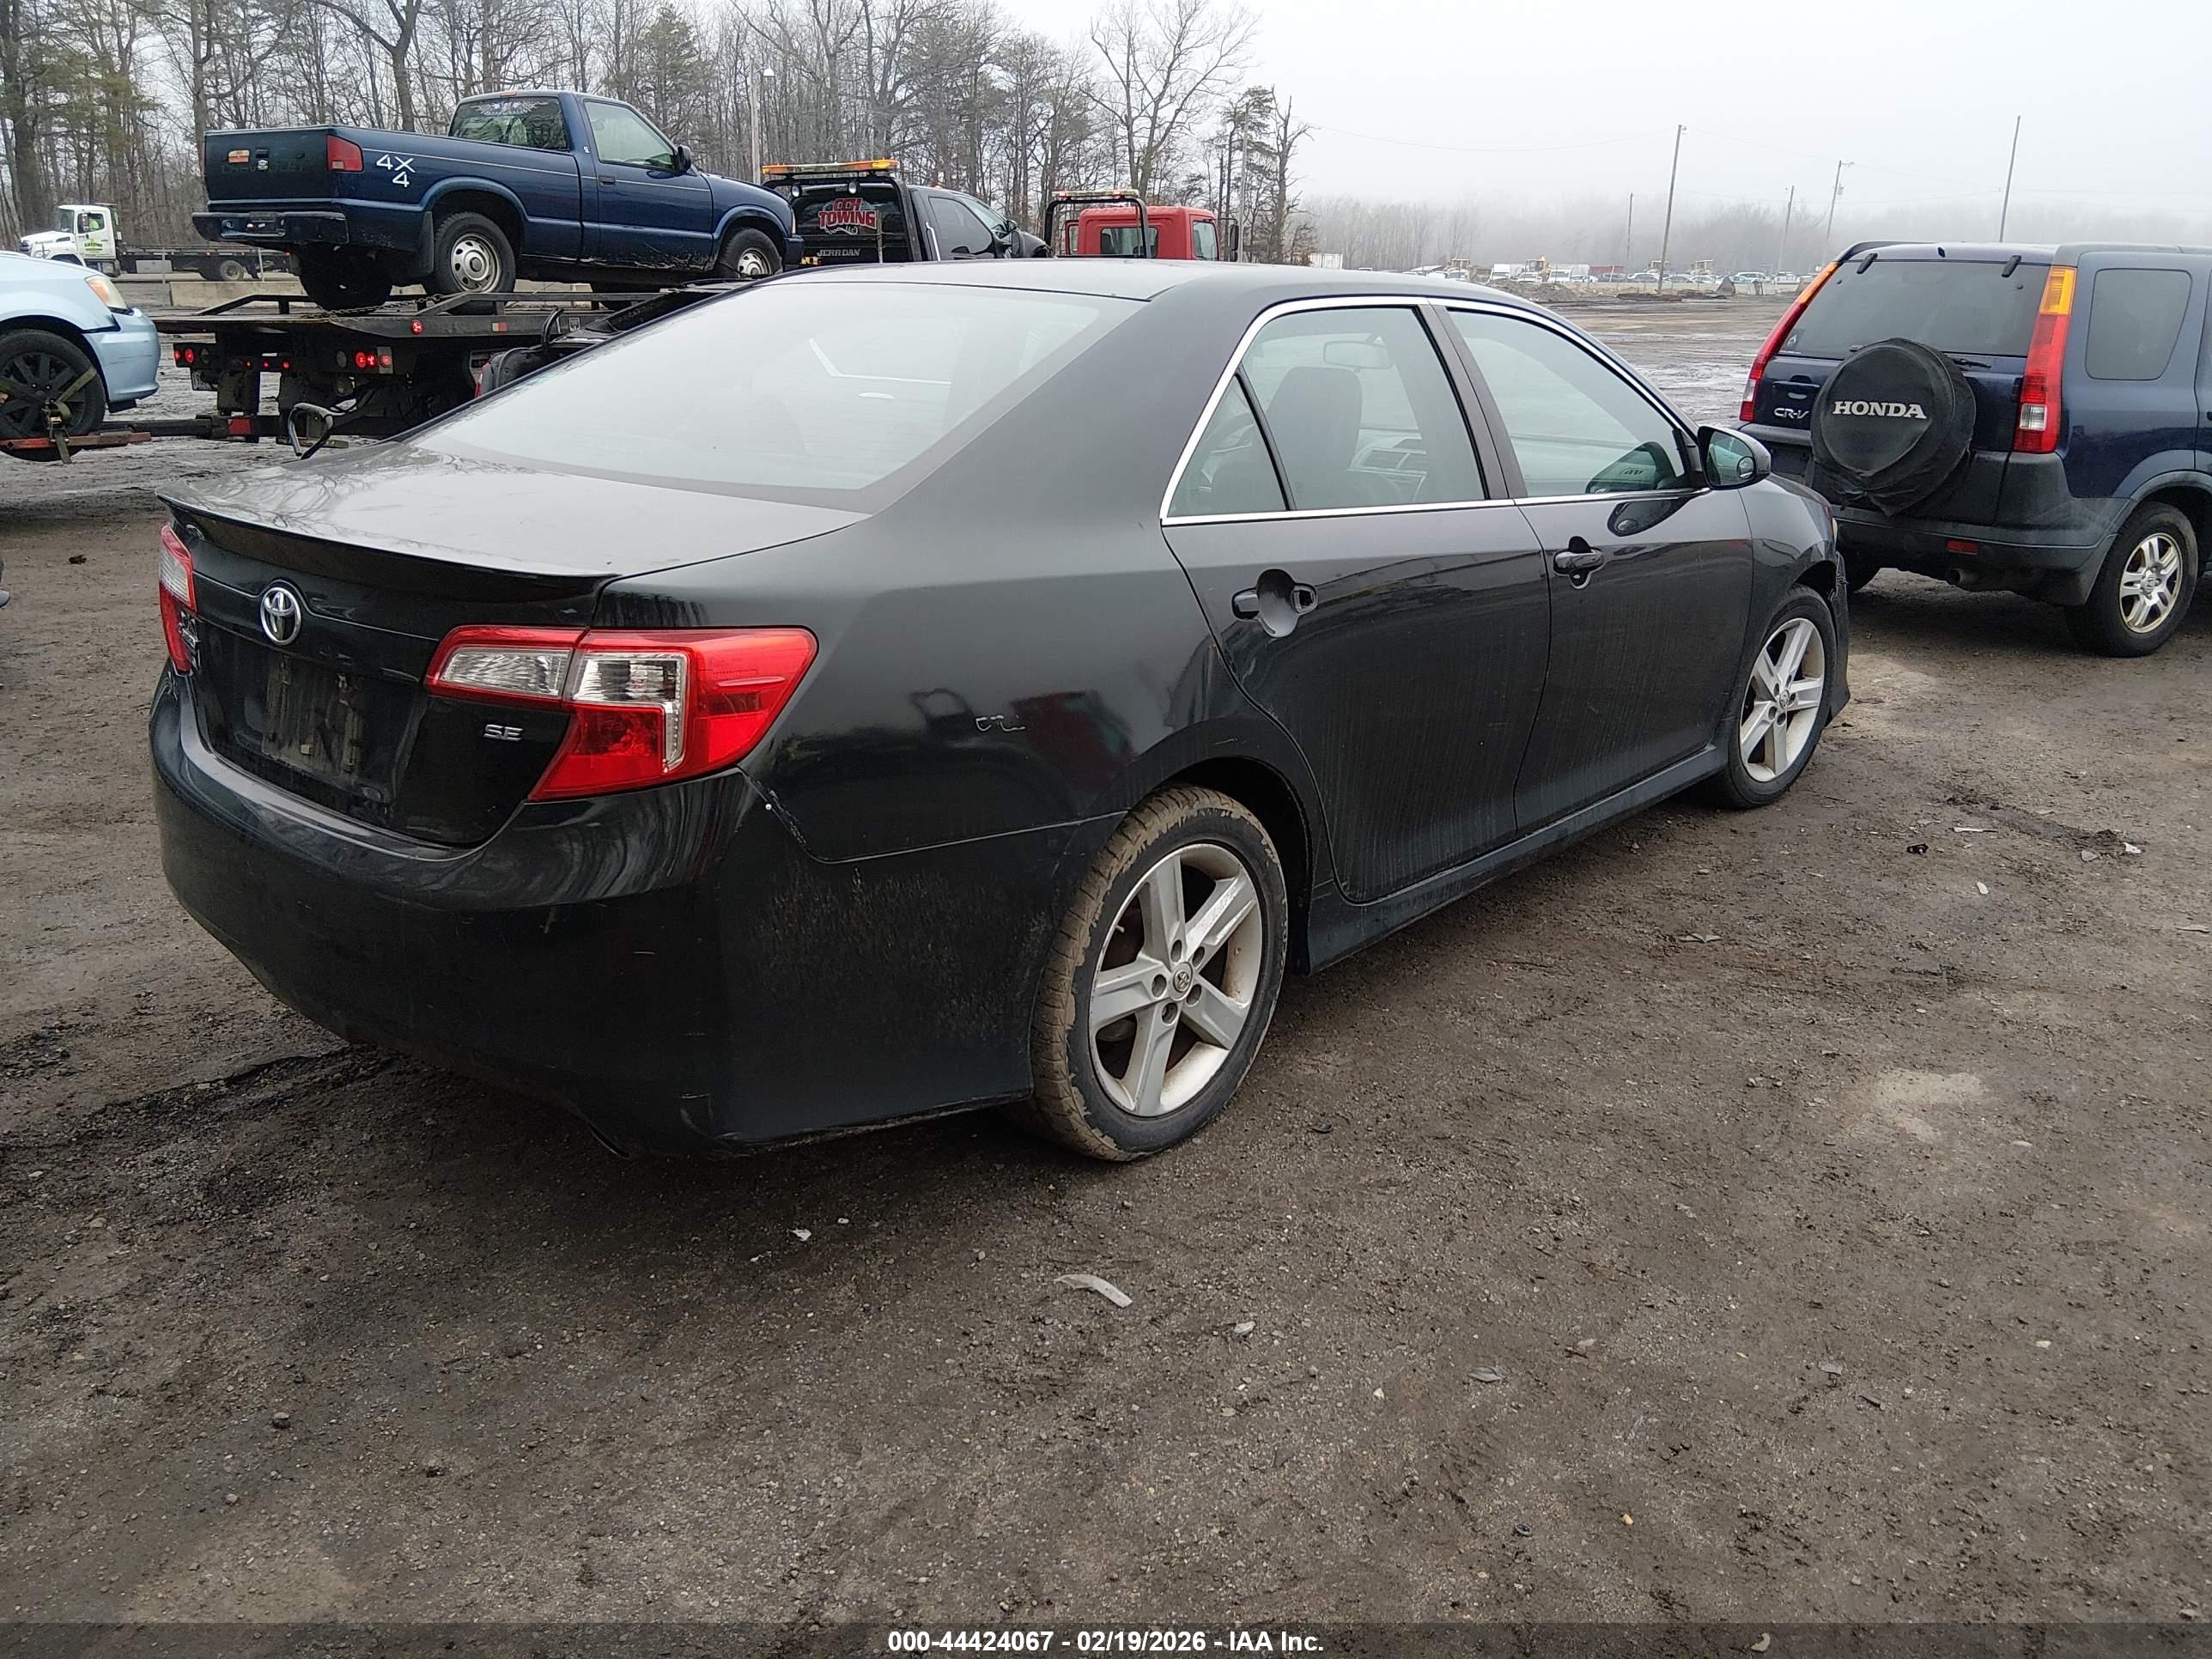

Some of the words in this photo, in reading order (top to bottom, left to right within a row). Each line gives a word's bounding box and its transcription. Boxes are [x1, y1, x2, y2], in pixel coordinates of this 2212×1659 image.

[818, 210, 877, 229] TOWING
[1773, 408, 1809, 420] CR-V
[1832, 401, 1927, 419] HONDA
[483, 724, 523, 742] SE
